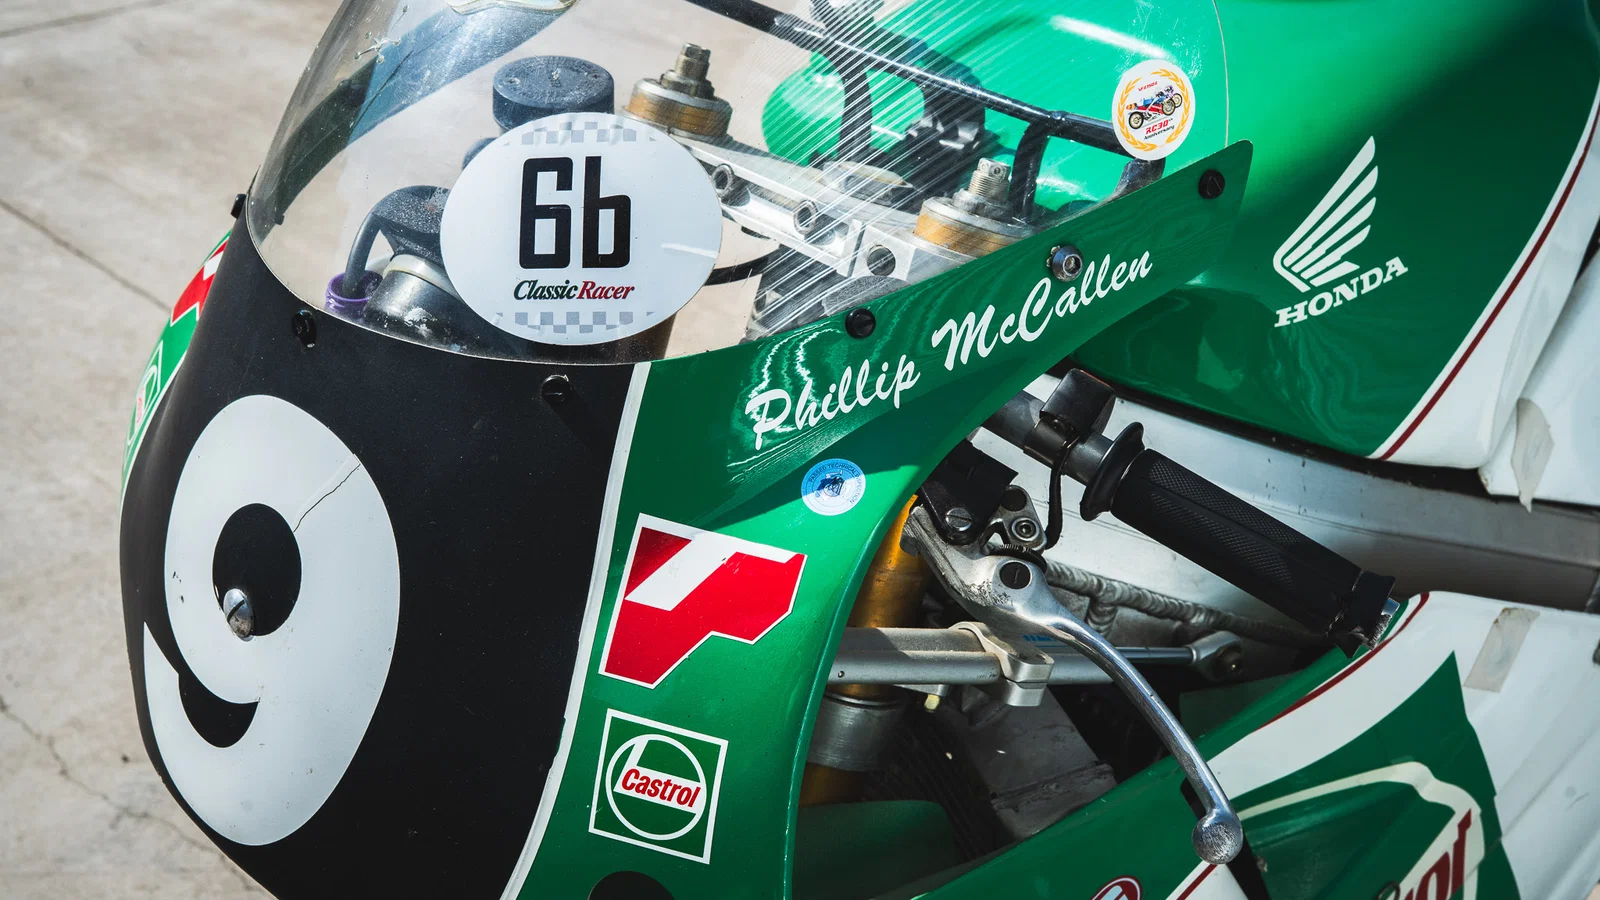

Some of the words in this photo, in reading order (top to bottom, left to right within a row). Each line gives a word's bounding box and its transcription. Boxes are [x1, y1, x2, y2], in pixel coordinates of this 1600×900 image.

[519, 156, 631, 269] 6b
[1274, 256, 1409, 327] HONDA
[746, 354, 920, 450] Phillip
[932, 250, 1153, 370] McCallen
[621, 768, 702, 808] Castrol
